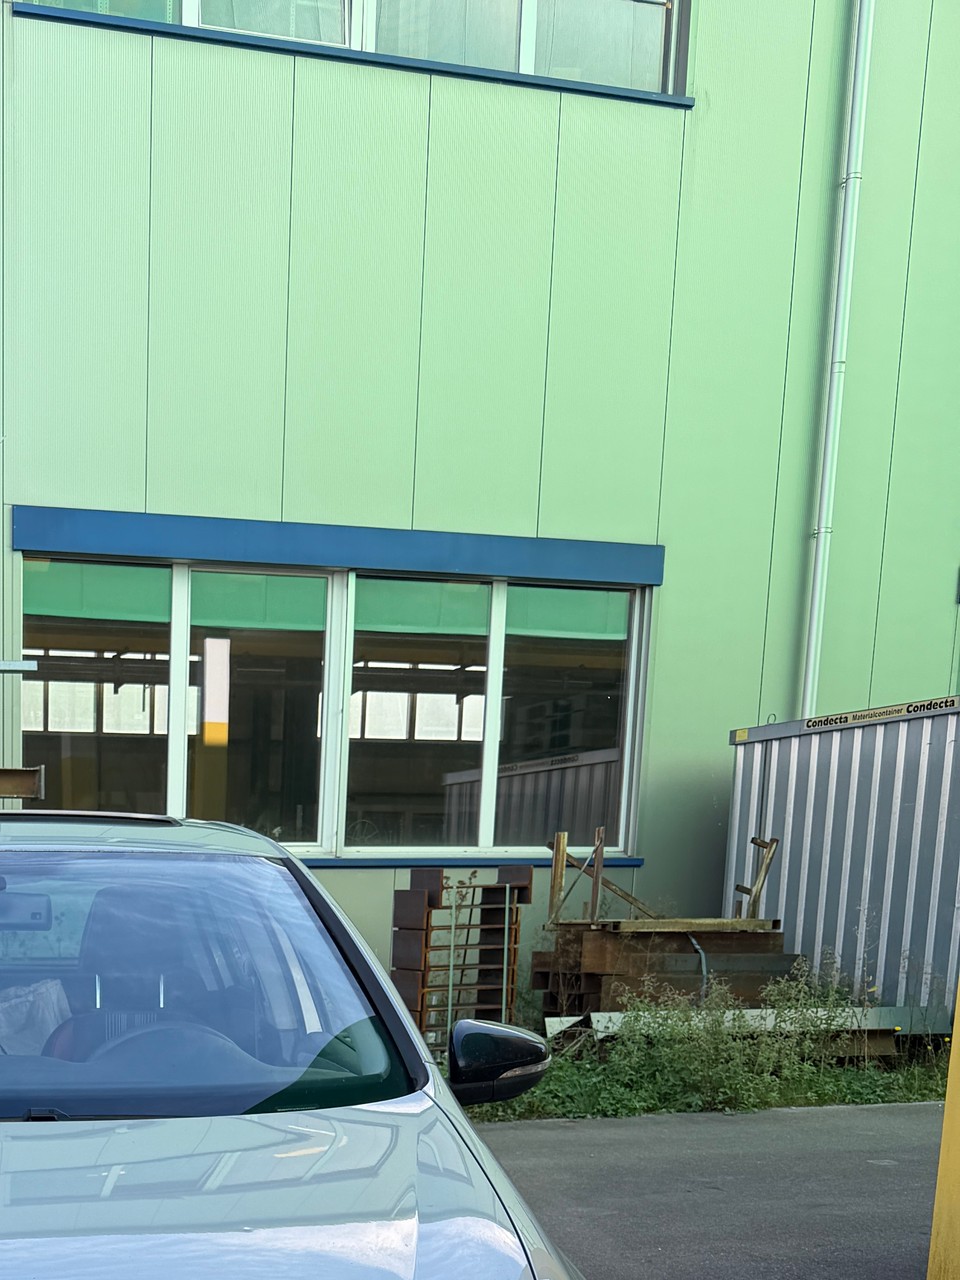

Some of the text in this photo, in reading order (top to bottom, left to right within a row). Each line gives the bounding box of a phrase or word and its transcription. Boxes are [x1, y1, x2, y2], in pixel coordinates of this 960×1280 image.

[806, 699, 955, 728] Condecta Materialcontainer Condecta
